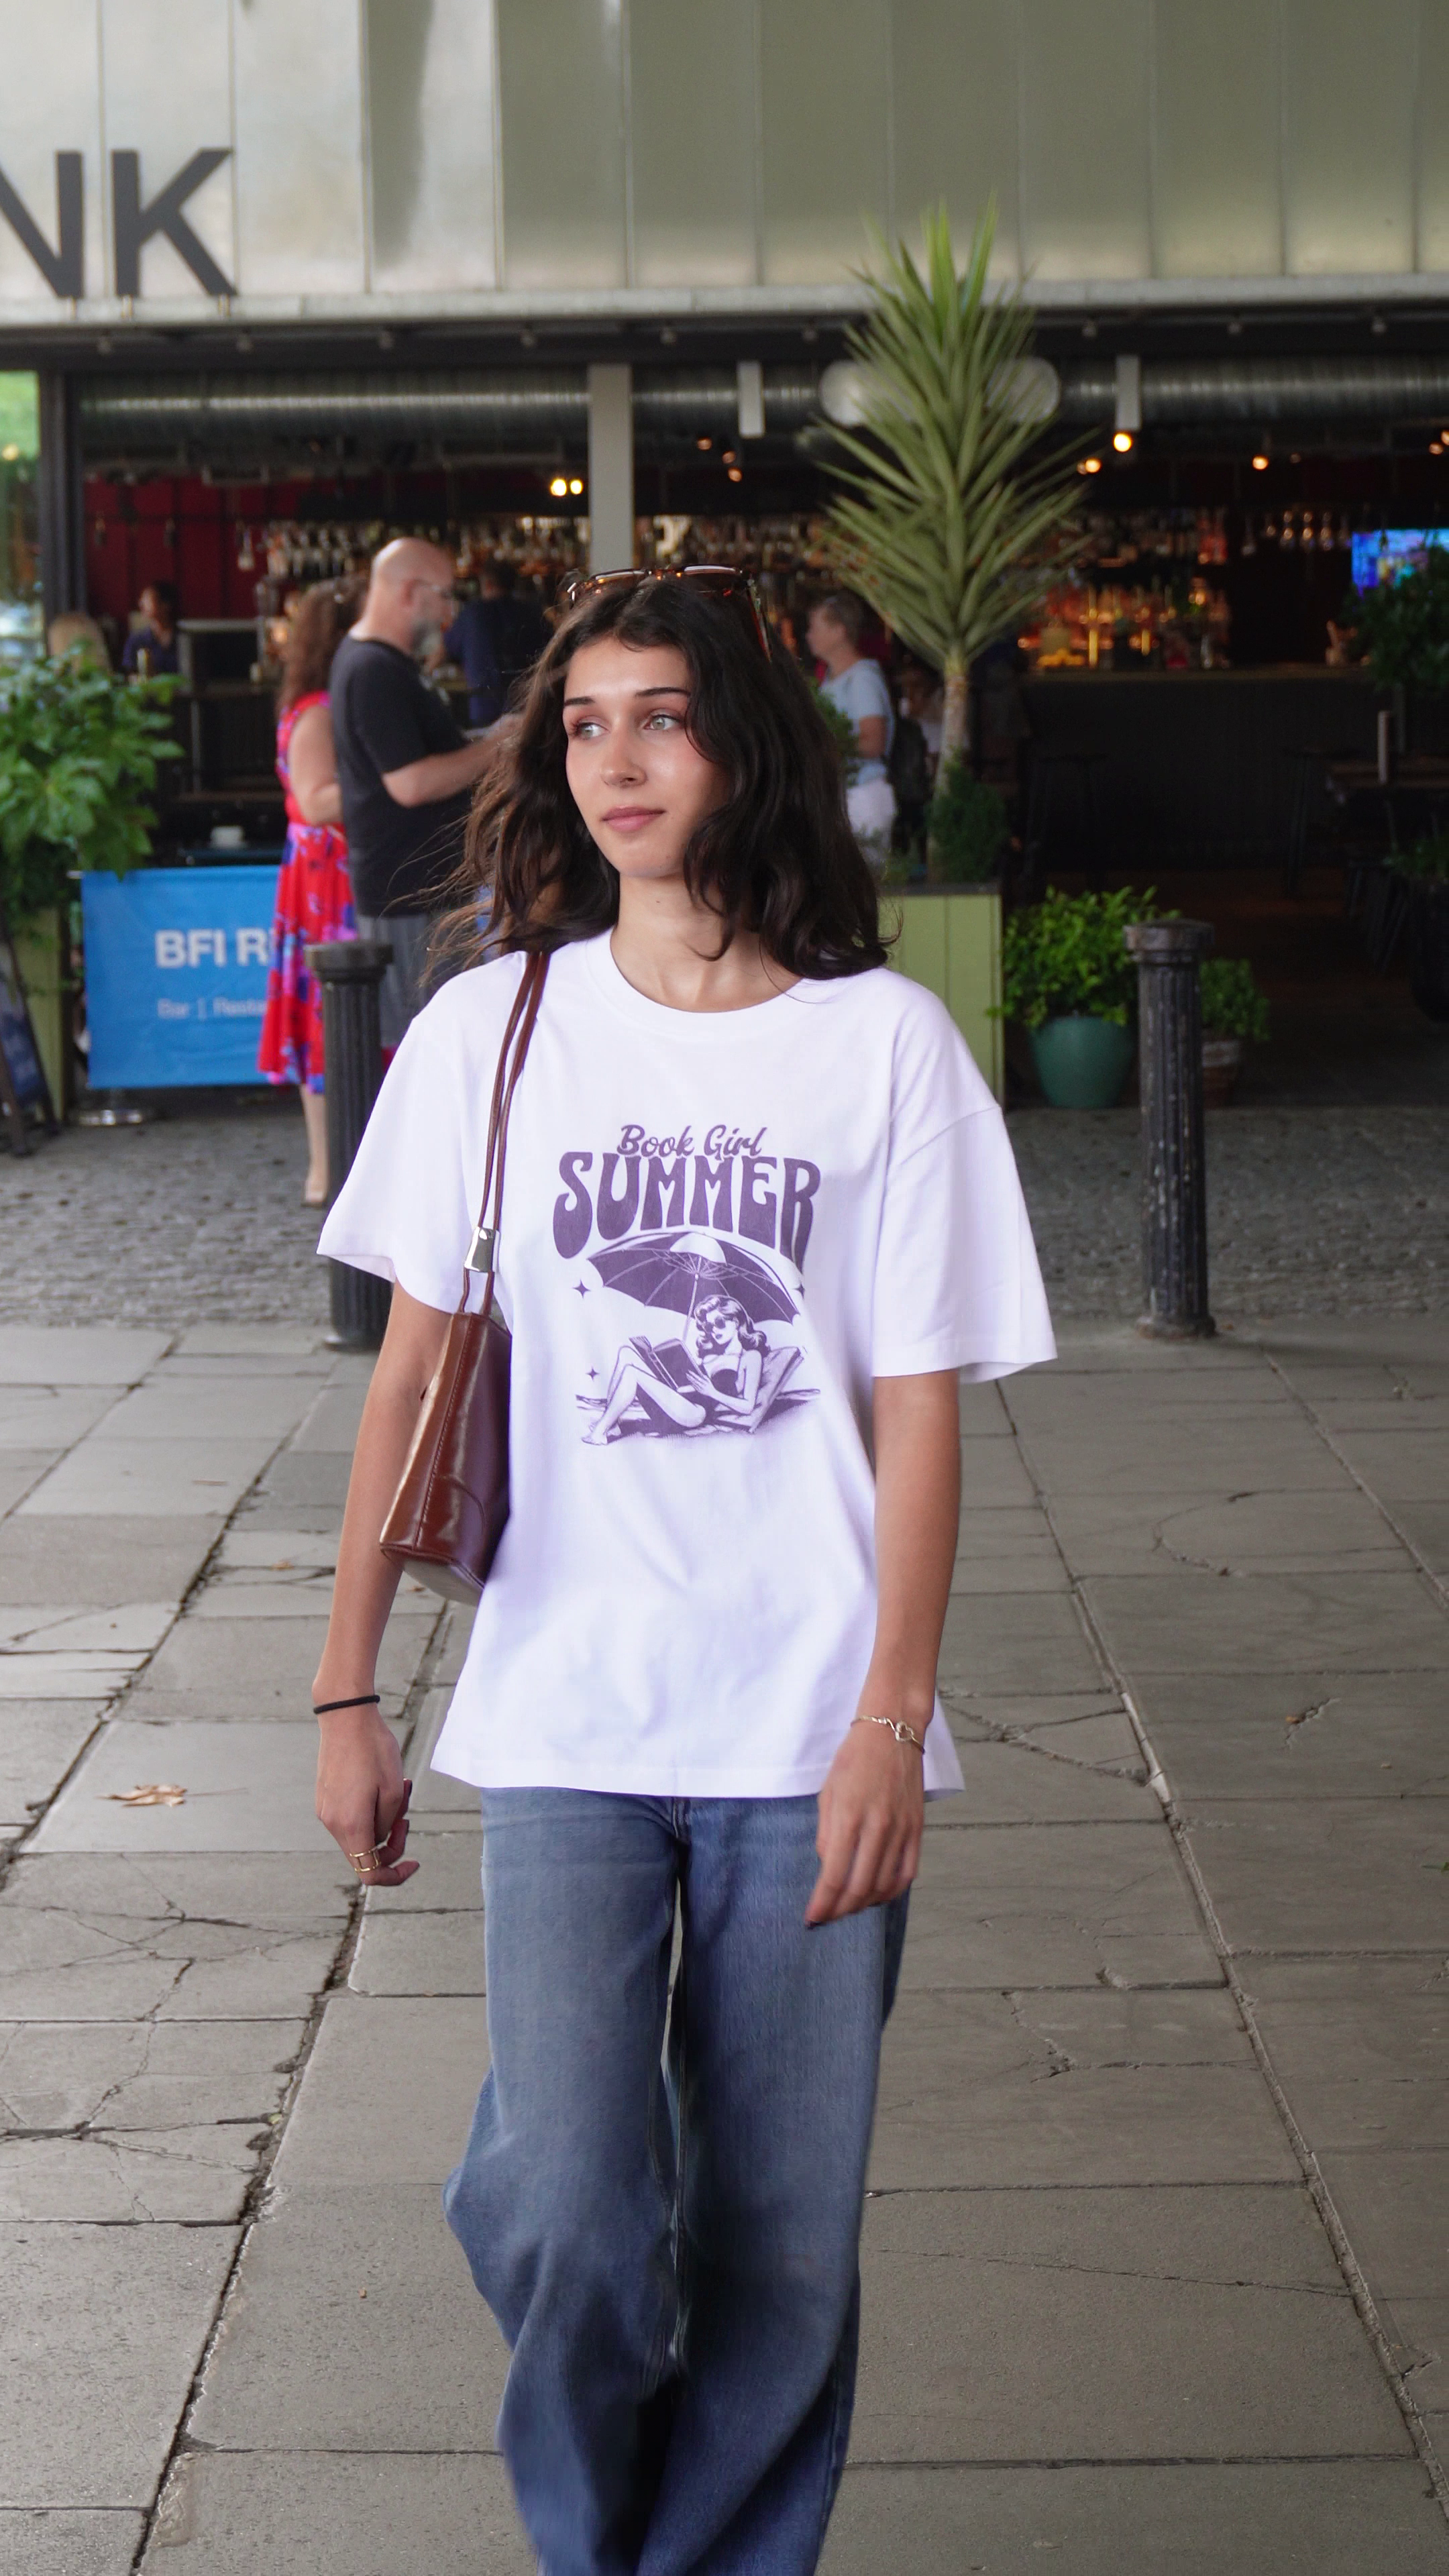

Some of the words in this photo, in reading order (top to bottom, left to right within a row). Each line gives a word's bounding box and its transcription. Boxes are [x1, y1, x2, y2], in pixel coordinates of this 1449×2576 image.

[155, 929, 226, 968] BFI
[616, 1124, 694, 1157] Book
[704, 1124, 767, 1161] Girl
[553, 1152, 820, 1275] SUMMER
